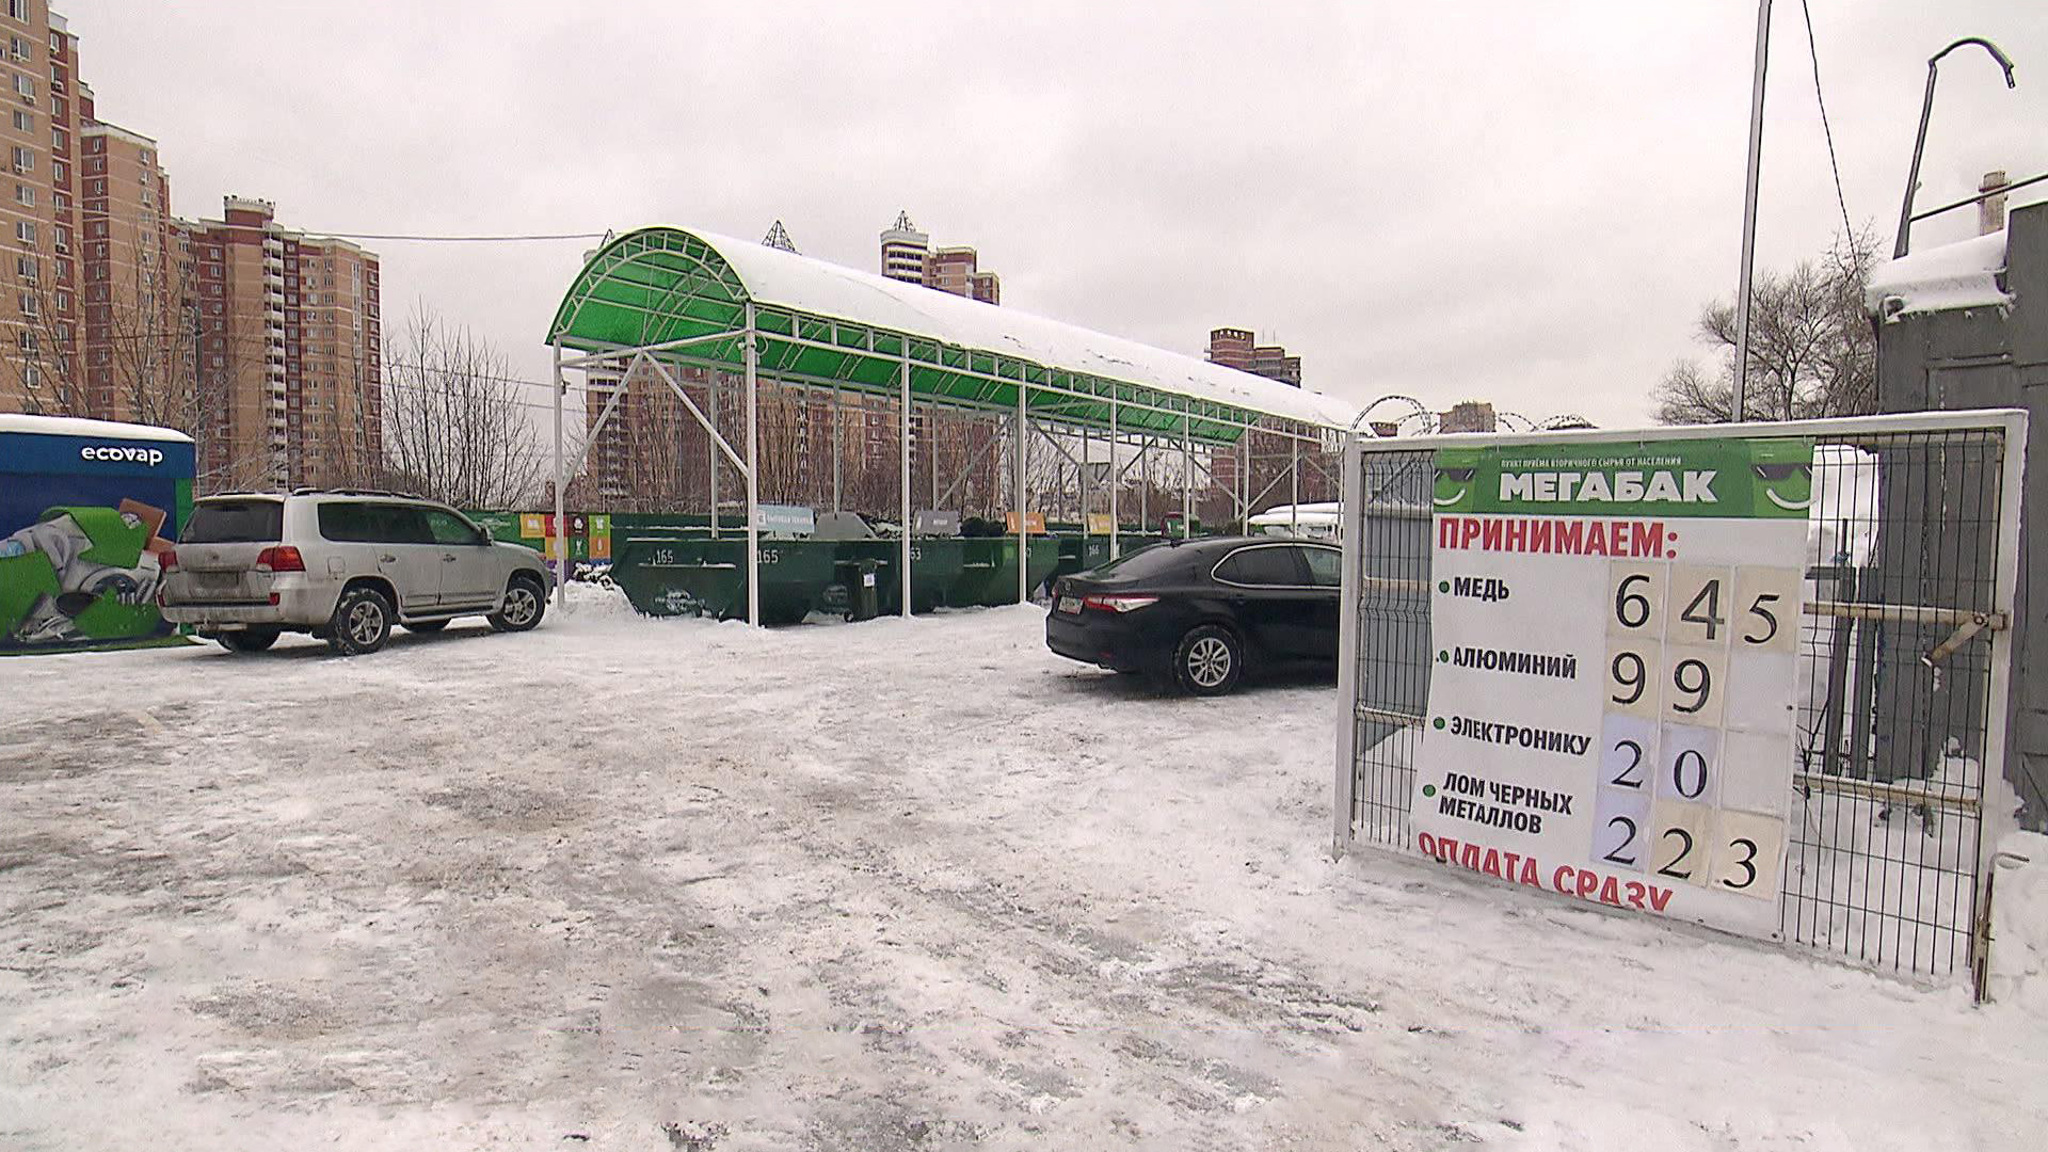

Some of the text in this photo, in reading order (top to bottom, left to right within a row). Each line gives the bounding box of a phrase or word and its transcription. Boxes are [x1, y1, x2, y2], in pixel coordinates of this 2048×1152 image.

[82, 446, 163, 466] ecovap
[1499, 470, 1718, 503] МЕГАБАК
[1438, 518, 1679, 559] ПРИНИМАЕМ:
[1453, 577, 1510, 602] МЕДЬ
[1453, 647, 1577, 680] АЛЮМИНИЙ
[1450, 716, 1592, 756] ЭЛЕКТРОНИКУ
[1442, 773, 1573, 815] ЛОМ ЧЕРНЫХ
[1438, 796, 1542, 834] МЕТАЛЛОВ
[1418, 831, 1673, 912] ОПЛАТА СРАЗУ
